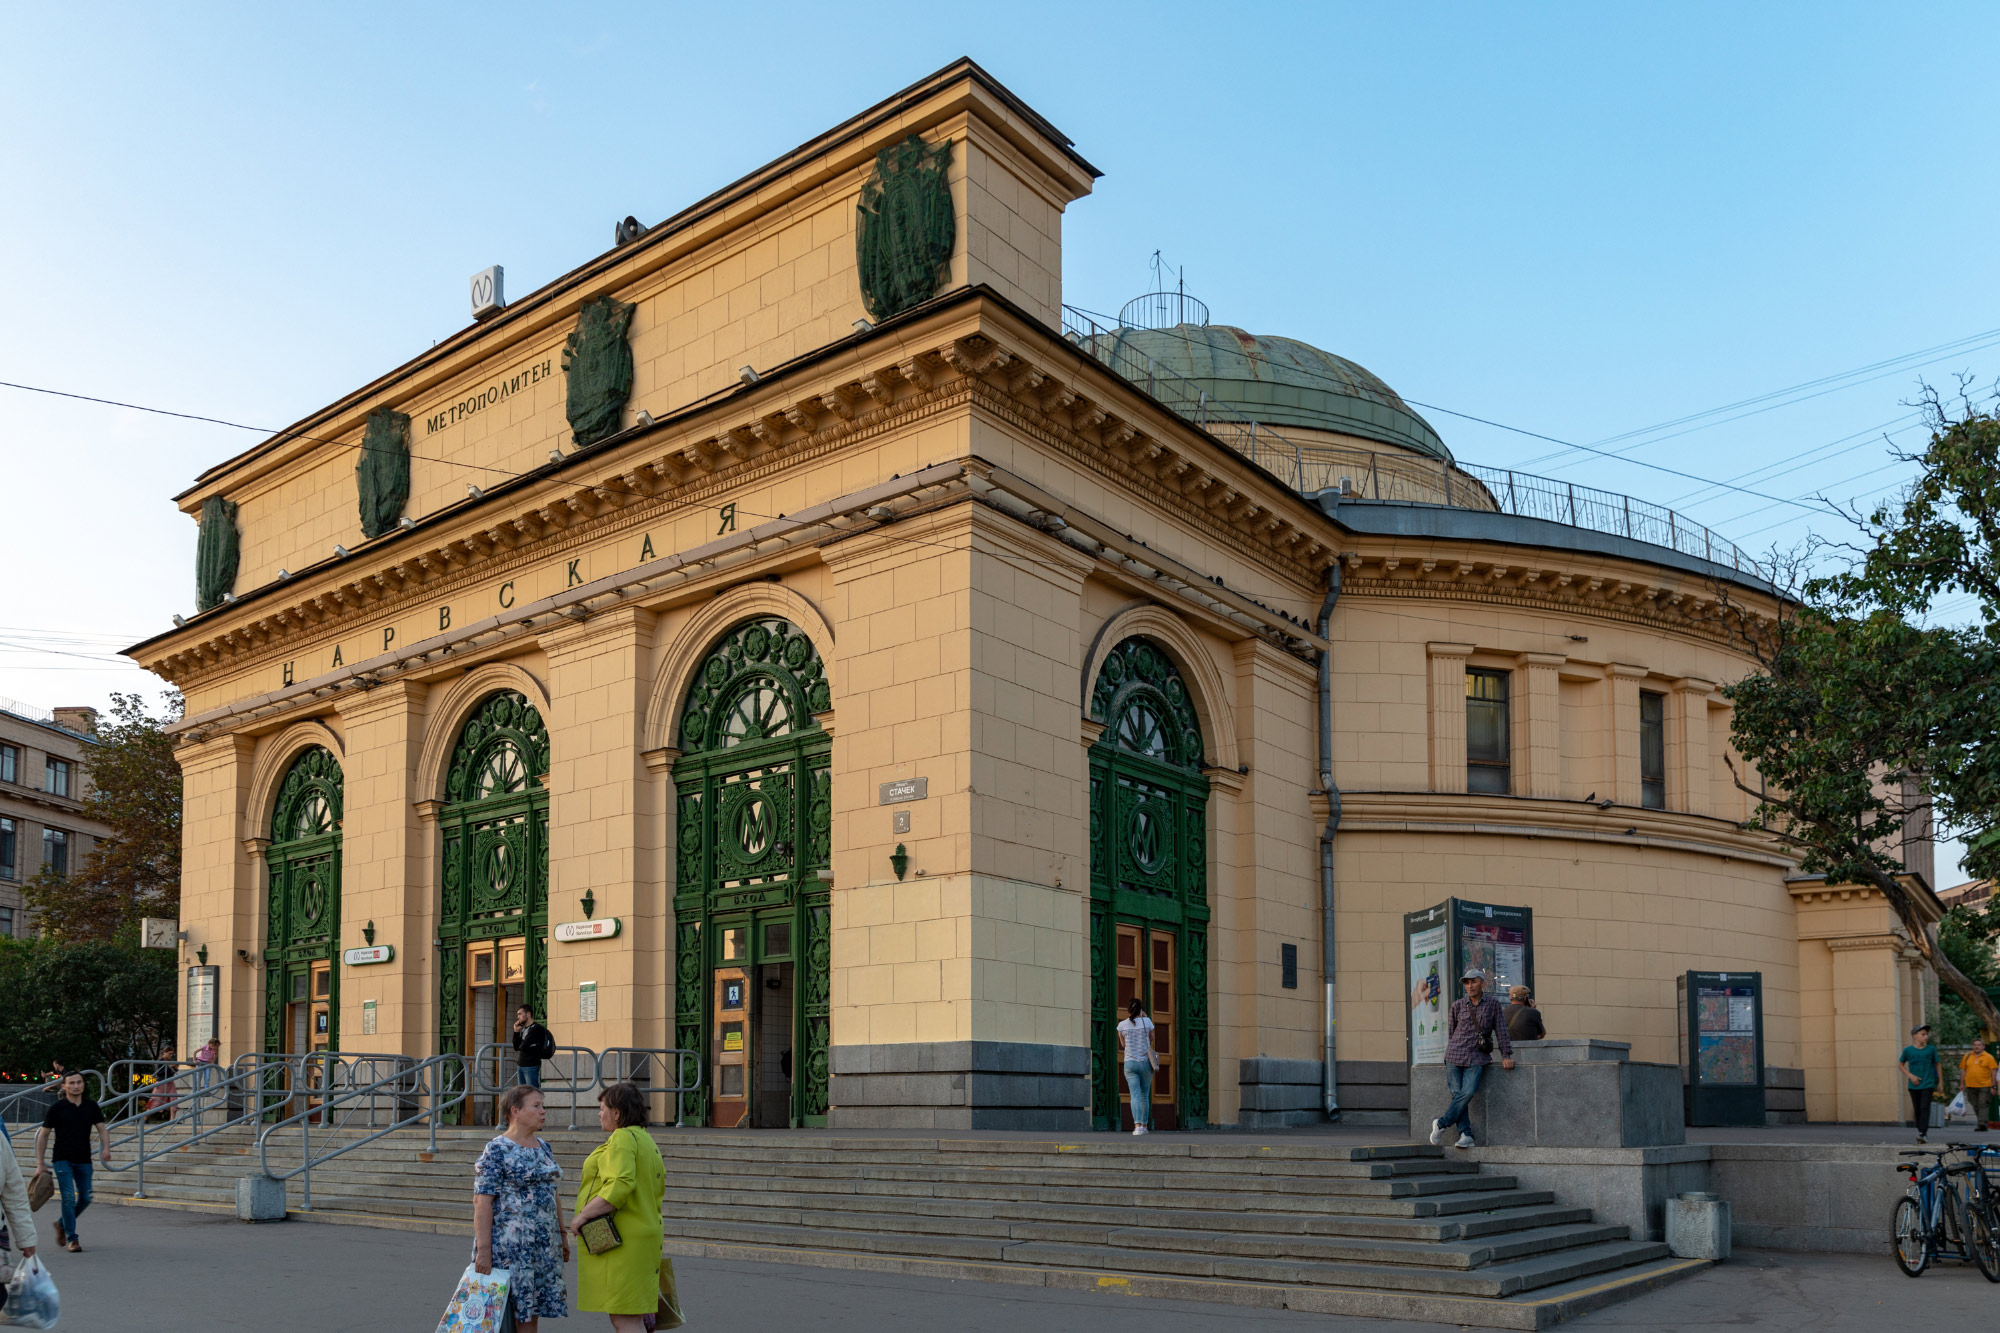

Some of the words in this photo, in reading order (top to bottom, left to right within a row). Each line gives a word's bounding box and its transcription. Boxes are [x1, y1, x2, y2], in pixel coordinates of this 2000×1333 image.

[427, 359, 551, 435] МЕТРОПОЛИТЕН
[283, 502, 737, 686] НАРВСКАЯ
[889, 785, 915, 797] СТАЧЕК
[899, 817, 904, 826] 2
[733, 891, 767, 905] ВХОД
